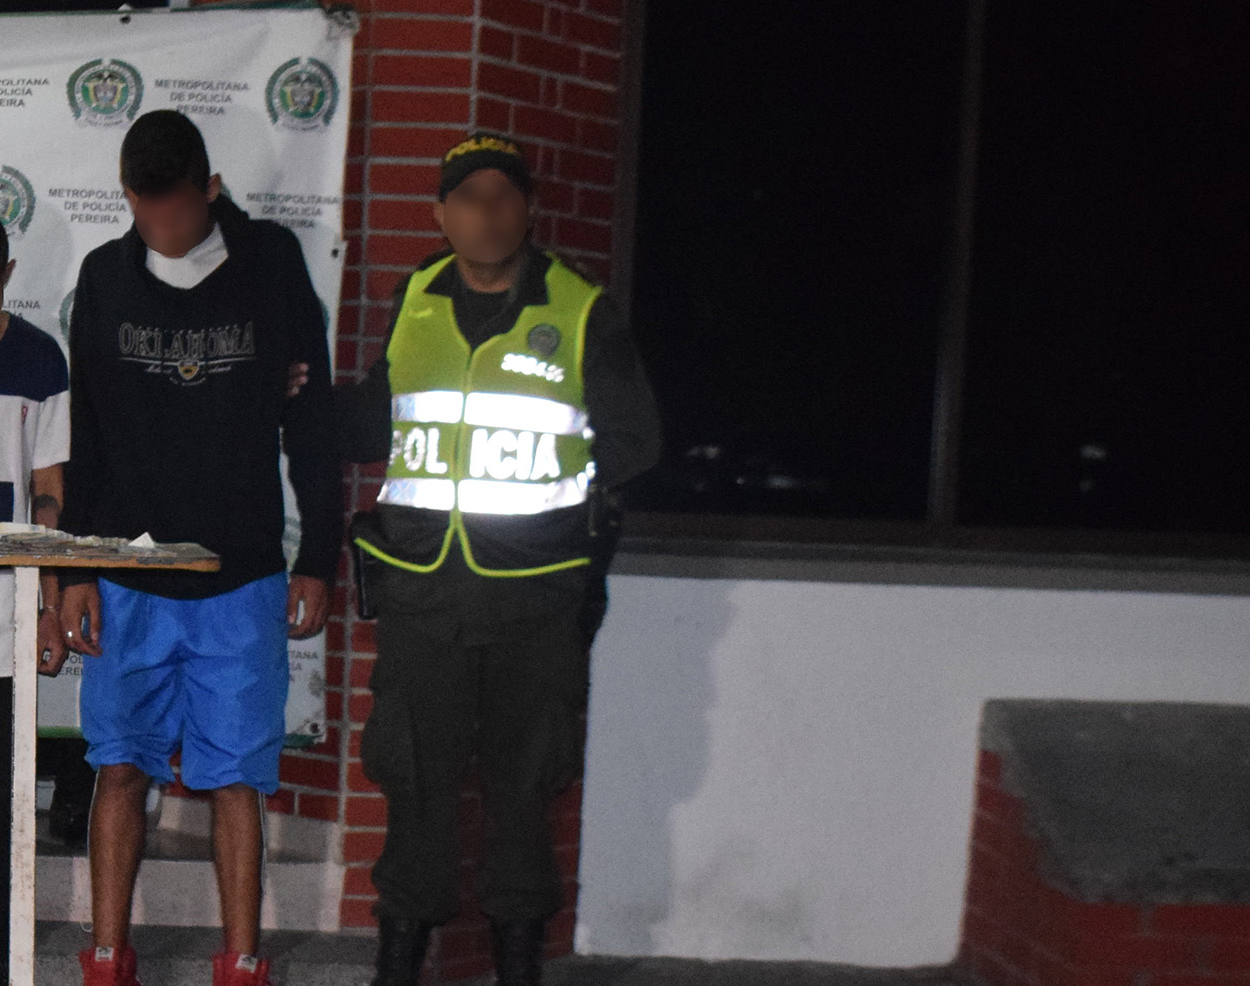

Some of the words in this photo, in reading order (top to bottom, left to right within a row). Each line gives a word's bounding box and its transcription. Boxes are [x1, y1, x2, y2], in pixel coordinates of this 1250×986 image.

[48, 188, 127, 200] METROPOLITA
[64, 201, 78, 210] DE
[70, 213, 119, 224] PEREIRA
[119, 321, 256, 358] OKLAHOMA
